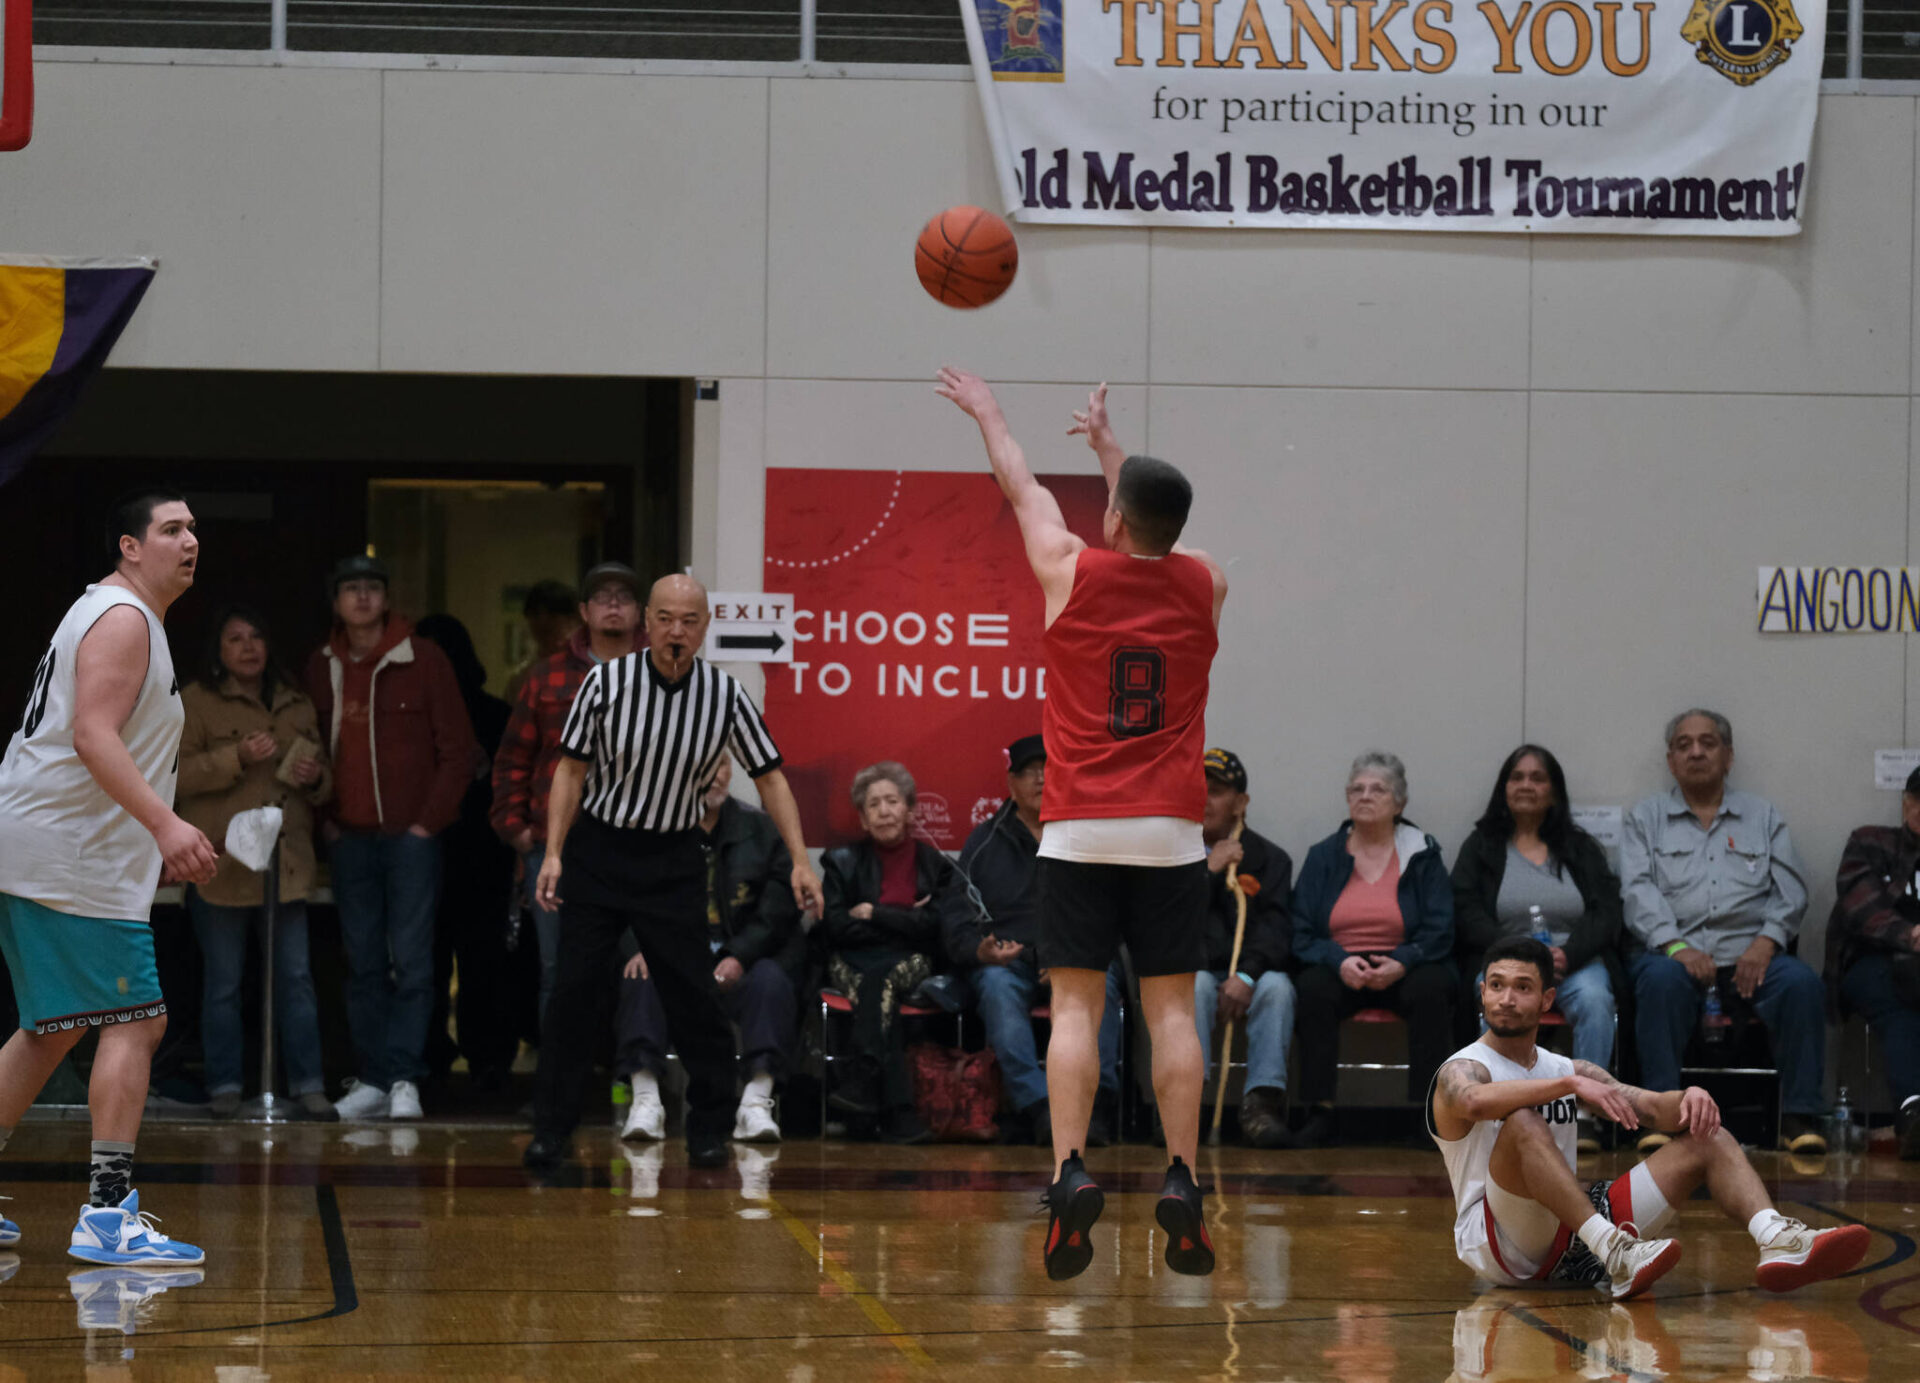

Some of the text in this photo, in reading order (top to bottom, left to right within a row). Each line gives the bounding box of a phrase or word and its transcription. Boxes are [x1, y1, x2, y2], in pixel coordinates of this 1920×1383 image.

[1102, 0, 1656, 77] THANKS YOU
[1728, 5, 1762, 46] L
[1706, 49, 1782, 75] INTERNATIONAL
[1152, 86, 1608, 137] for participating in our
[1015, 148, 1071, 209] ld
[1083, 151, 1234, 211] Medal
[1246, 154, 1494, 217] Basketball
[714, 604, 786, 620] EXIT
[1758, 567, 1920, 632] ANGOON
[794, 610, 1010, 647] CHOOSE
[788, 662, 852, 696] TO
[1107, 646, 1166, 741] 8
